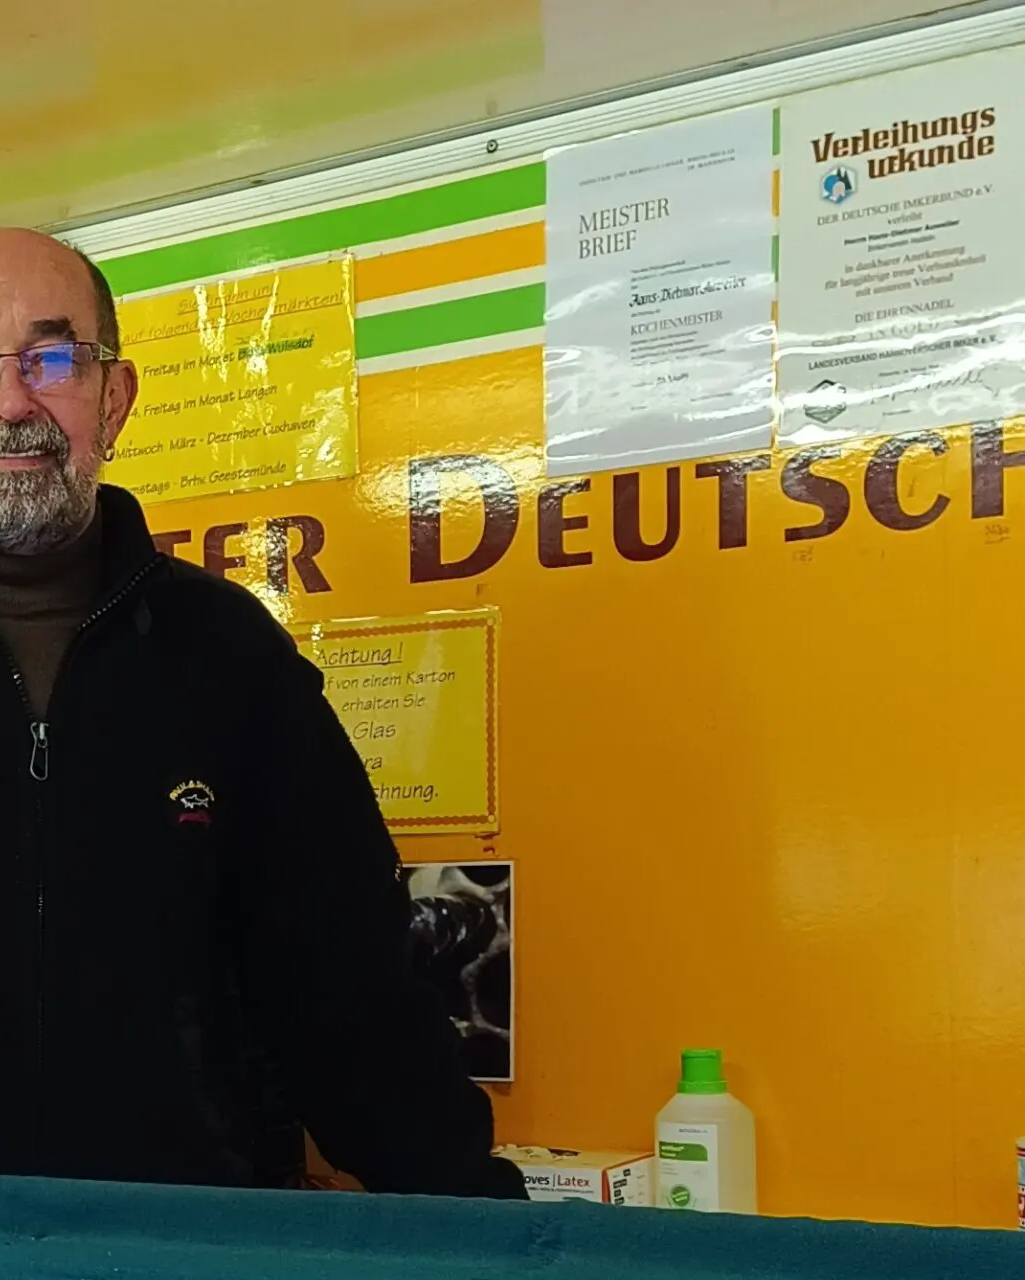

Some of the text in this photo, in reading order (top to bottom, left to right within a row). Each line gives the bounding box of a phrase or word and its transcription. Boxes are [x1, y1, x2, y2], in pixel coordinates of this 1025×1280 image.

[579, 197, 670, 235] MEISTER
[817, 213, 840, 226] DER
[842, 201, 901, 221] DEUTSCHE
[903, 187, 974, 210] IMKERBUND
[578, 229, 637, 260] BRIEF
[855, 299, 955, 324] DIE EHRENNADEL
[143, 350, 235, 379] Freitag im Monat
[143, 397, 181, 417] Freitag
[183, 393, 196, 408] im
[199, 390, 236, 408] Monat
[237, 385, 278, 404] Langen
[115, 441, 164, 460] Mittwoch
[169, 436, 197, 452] März
[207, 427, 260, 445] Dezember
[130, 480, 171, 497] mstags
[208, 461, 287, 484] Geestemünde
[151, 513, 333, 597] TER
[316, 646, 392, 667] Achtung
[336, 676, 358, 690] von
[363, 674, 402, 689] einem
[406, 670, 455, 686] Karton
[341, 694, 426, 713] erhalten Sie
[352, 721, 396, 740] Glas
[374, 782, 439, 803] chnung.
[524, 1173, 591, 1188] oves Latex
